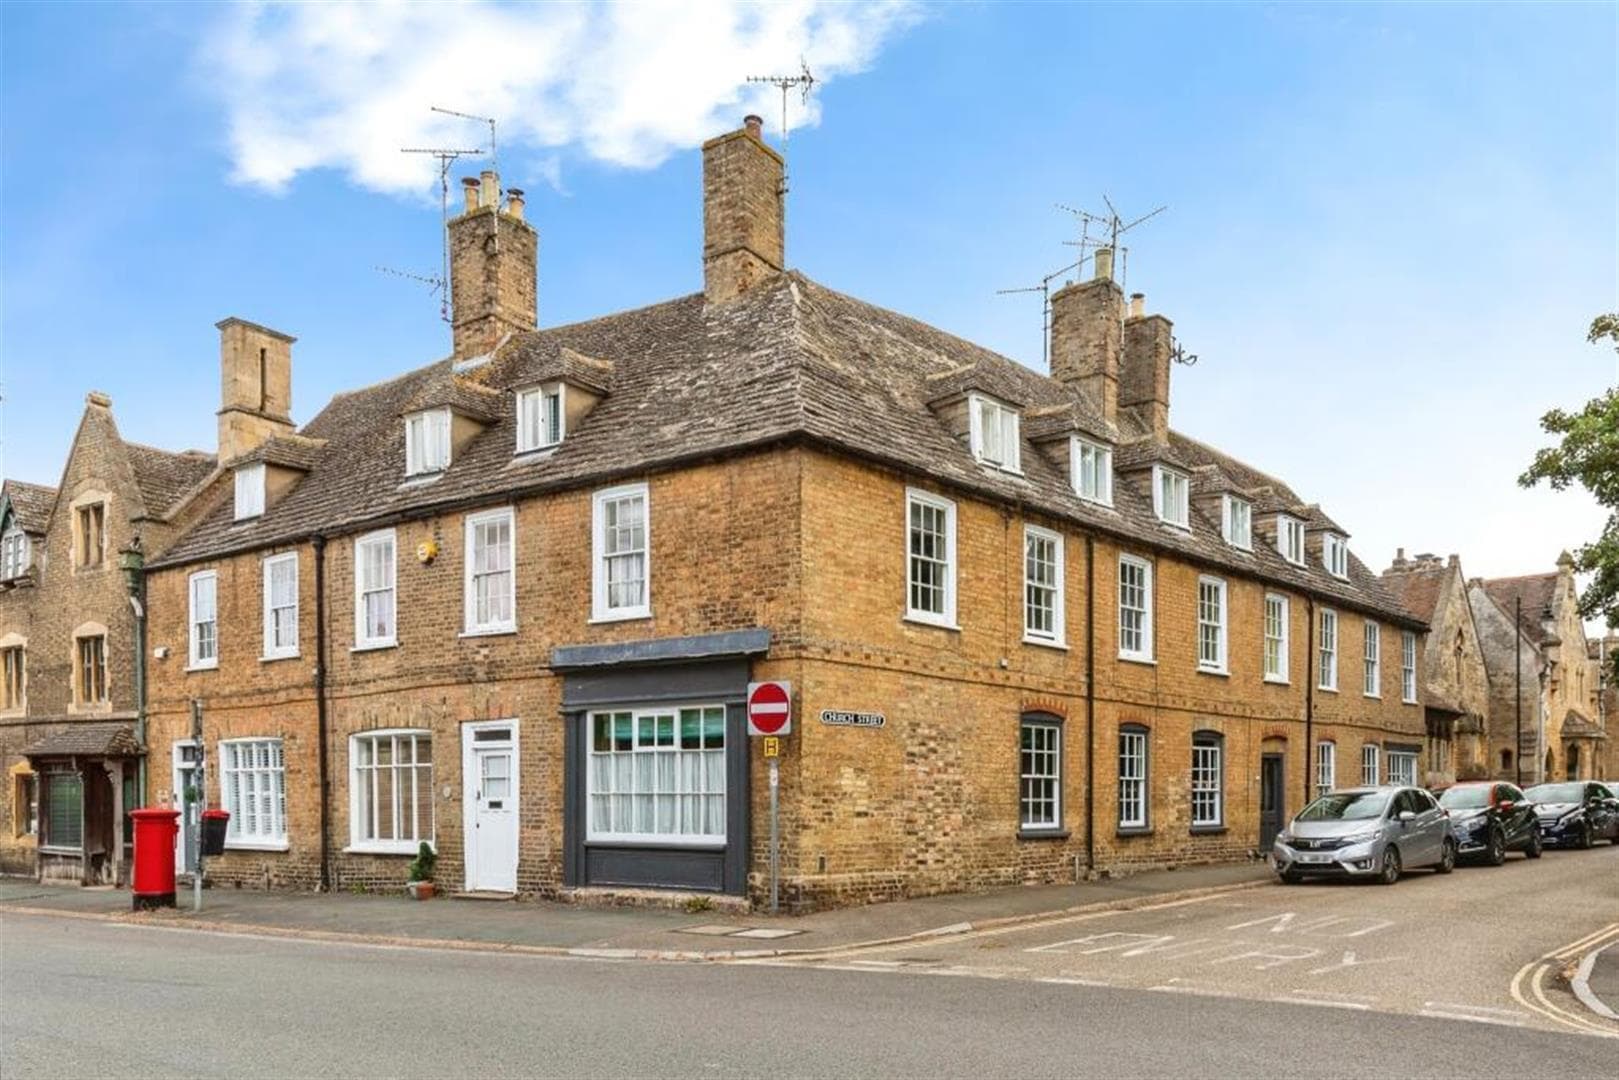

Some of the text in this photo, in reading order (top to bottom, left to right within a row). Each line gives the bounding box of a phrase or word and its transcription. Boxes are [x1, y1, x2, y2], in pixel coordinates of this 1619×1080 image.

[824, 712, 882, 726] CHURCH STREET
[766, 739, 777, 755] H
[1223, 911, 1399, 939] NO
[1023, 930, 1411, 976] ENTRY
